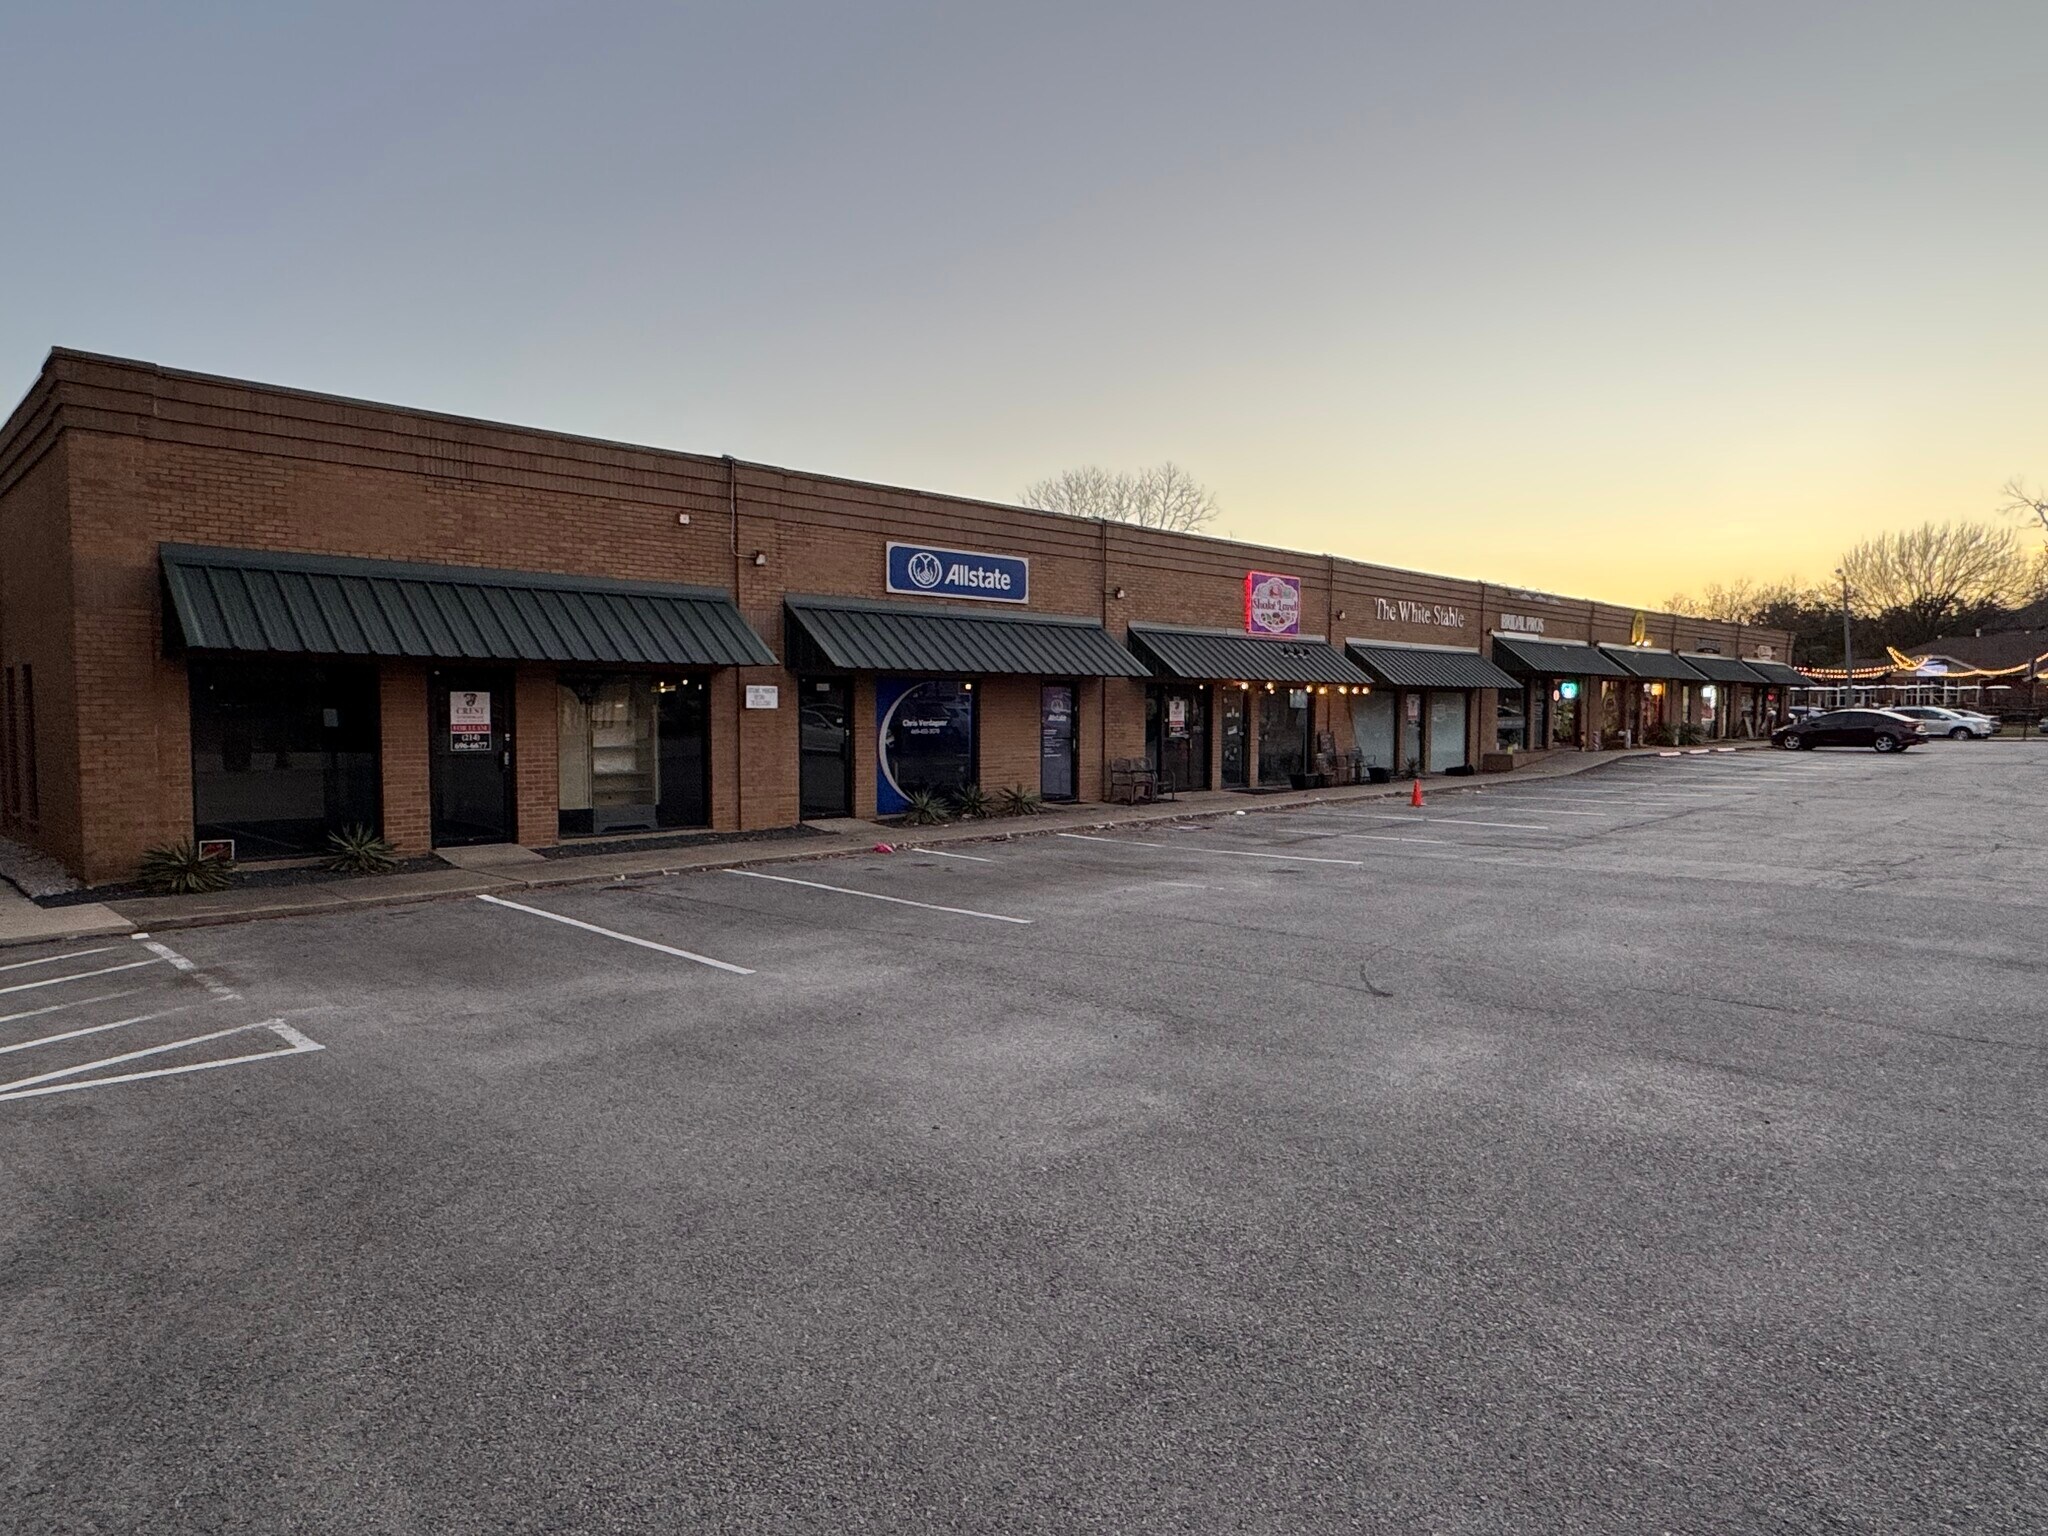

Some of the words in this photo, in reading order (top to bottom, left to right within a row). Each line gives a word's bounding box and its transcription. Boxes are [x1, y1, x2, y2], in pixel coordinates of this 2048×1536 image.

[944, 564, 1011, 590] Allstate
[1374, 597, 1396, 621] The
[1398, 601, 1431, 624] White
[1433, 605, 1465, 628] Stable
[1501, 613, 1526, 631] BRIDAL
[1526, 616, 1545, 633] PROS
[461, 734, 481, 742] (214)
